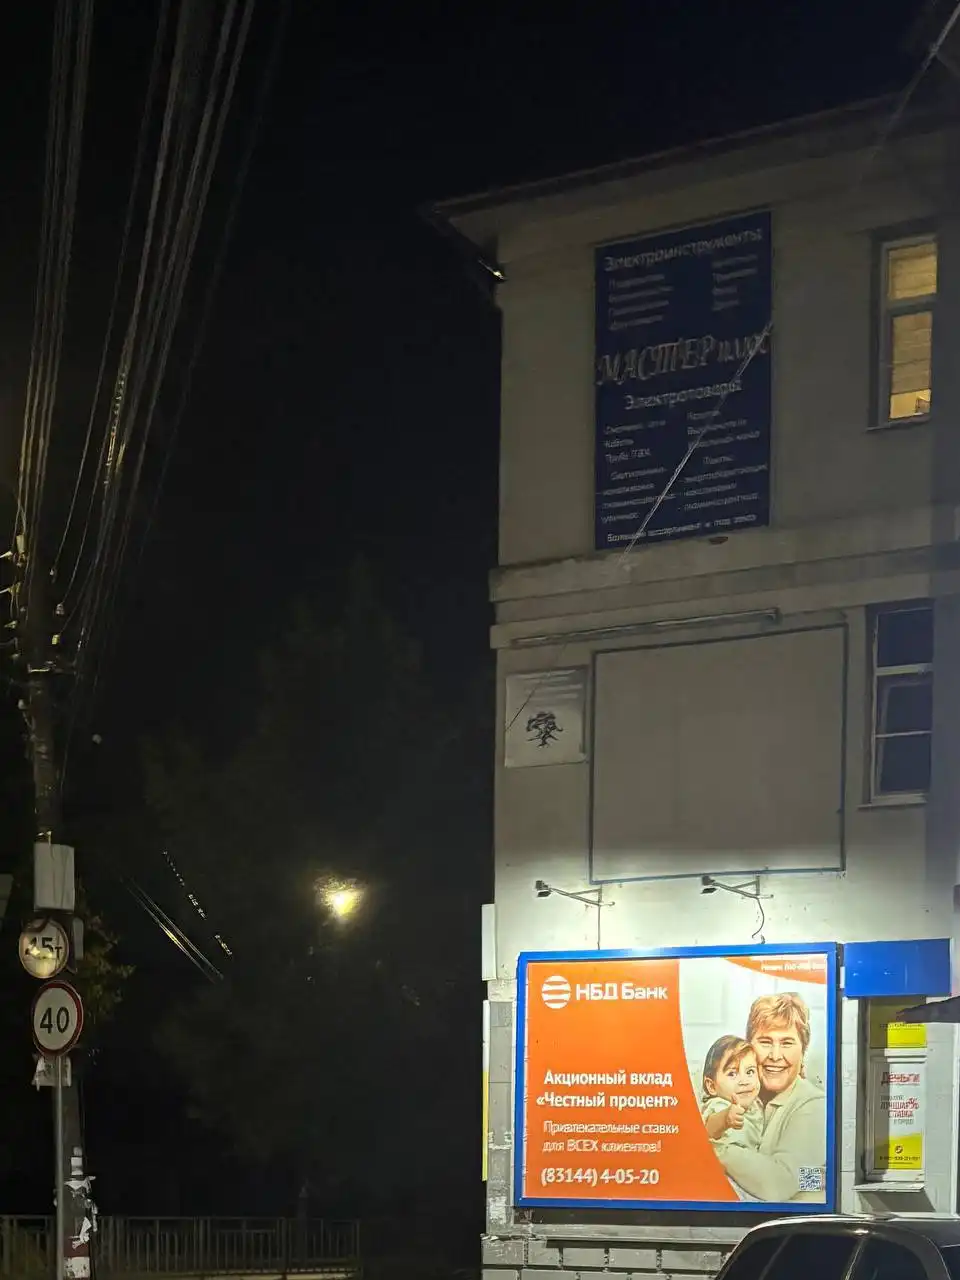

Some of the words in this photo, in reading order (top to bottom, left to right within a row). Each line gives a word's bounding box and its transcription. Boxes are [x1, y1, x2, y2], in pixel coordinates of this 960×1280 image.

[575, 983, 618, 1001] НБД
[621, 983, 668, 1001] Банк
[40, 1006, 70, 1034] 40
[544, 1070, 626, 1087] Акционный
[630, 1072, 673, 1087] вклад
[536, 1091, 606, 1108] «Честный
[609, 1096, 679, 1111] процент»
[641, 1125, 680, 1134] ставки
[566, 1140, 598, 1152] ВСЕХ
[541, 1167, 598, 1187] (83144)
[600, 1169, 660, 1185] 4-05-20
